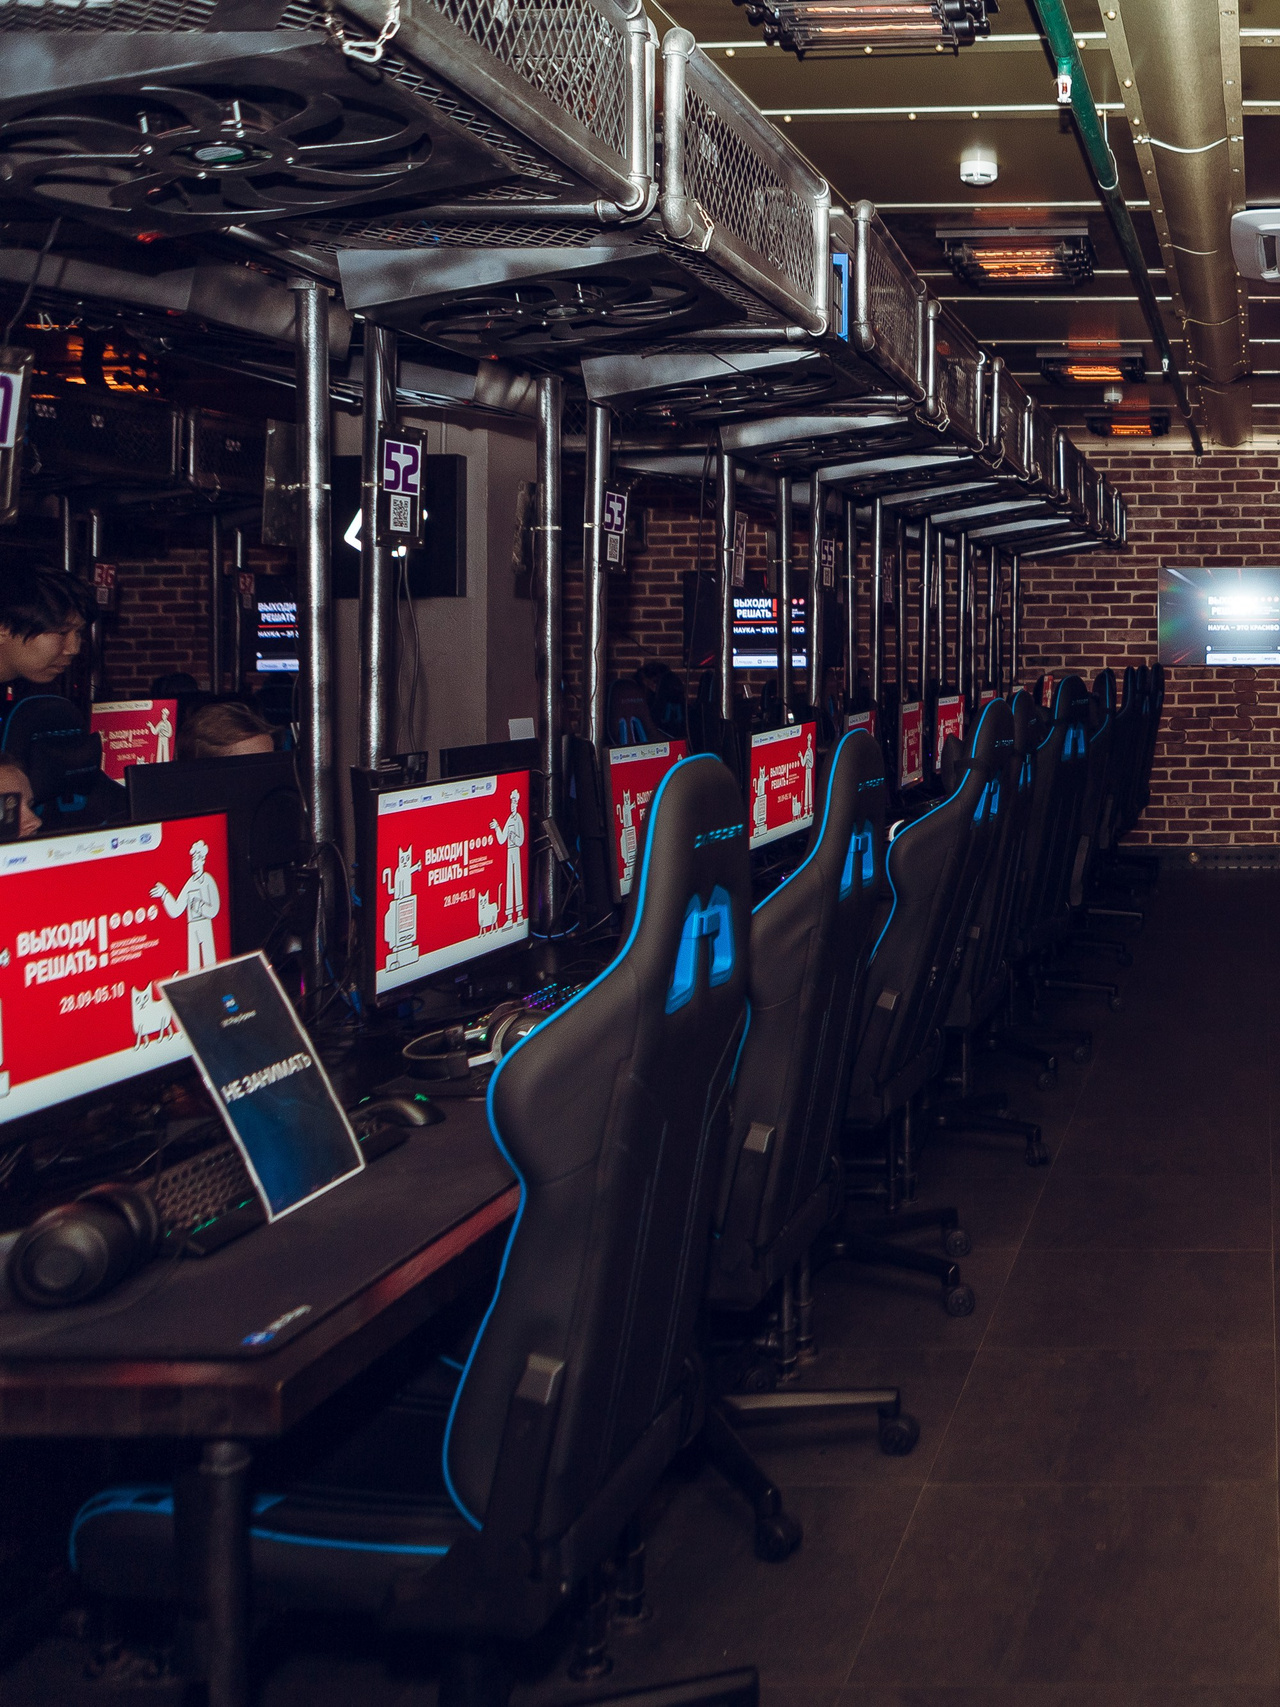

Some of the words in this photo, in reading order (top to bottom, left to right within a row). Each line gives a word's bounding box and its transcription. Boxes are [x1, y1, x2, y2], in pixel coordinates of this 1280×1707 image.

[384, 441, 420, 494] 52
[604, 493, 626, 533] 53
[821, 540, 834, 566] 55
[733, 598, 772, 609] ВЫХОДИ
[733, 626, 756, 634] НАУКА
[761, 626, 775, 634] ЭТО
[425, 841, 463, 866] ВЫХОДИ
[16, 916, 97, 959] ВЫХОДИ
[59, 981, 126, 1016] 28.09-05.10
